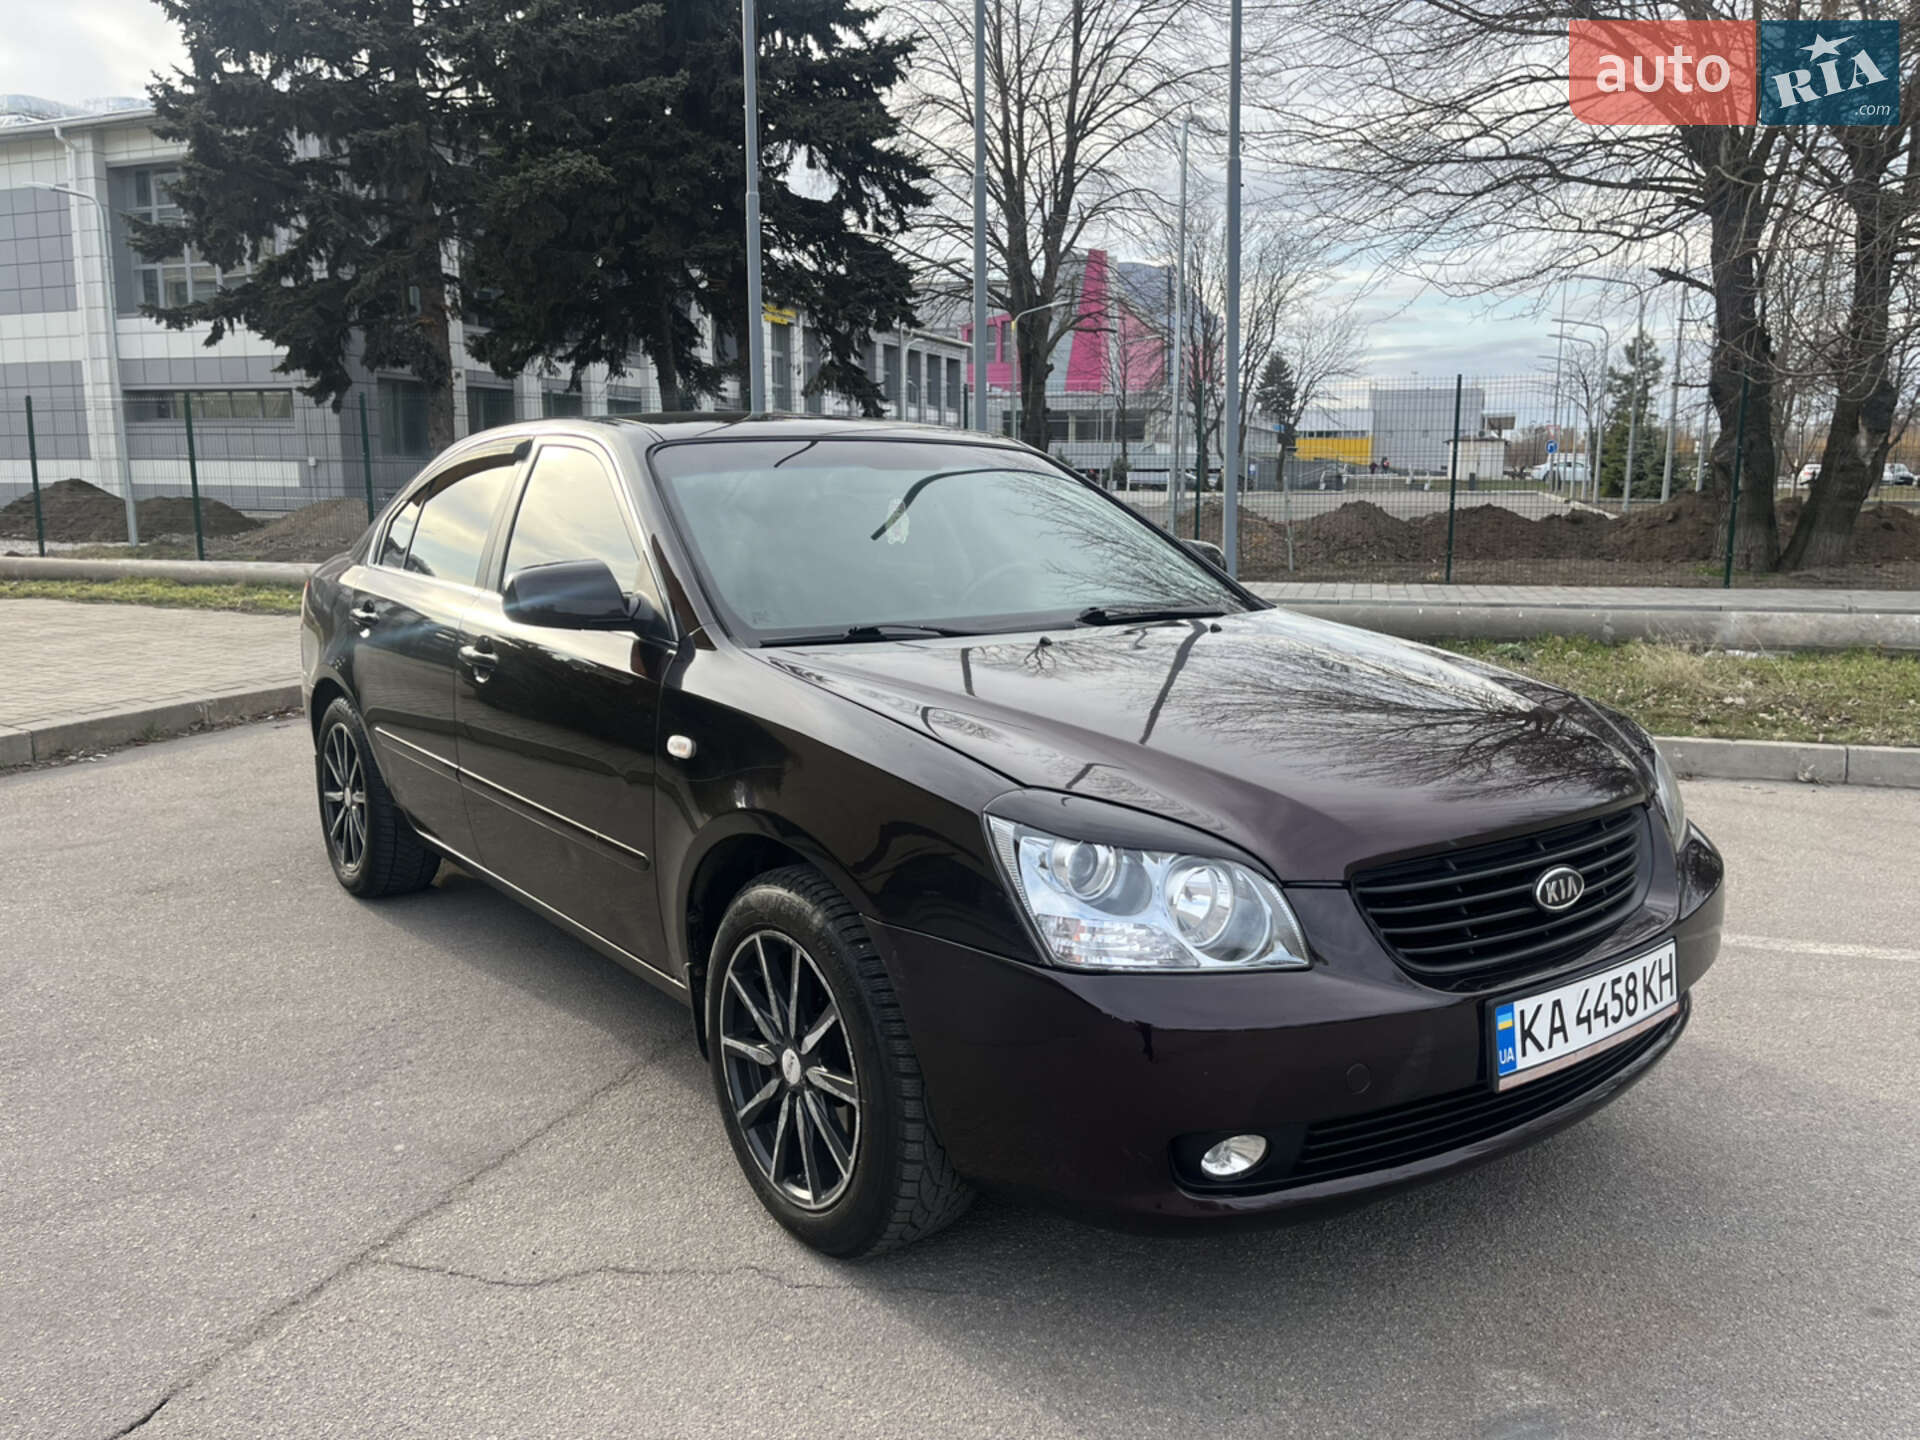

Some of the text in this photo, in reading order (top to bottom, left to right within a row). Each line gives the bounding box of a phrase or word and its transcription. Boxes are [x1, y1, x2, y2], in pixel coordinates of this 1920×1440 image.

[1545, 876, 1578, 904] KIA
[1519, 998, 1569, 1058] KA
[1499, 1047, 1515, 1064] UA
